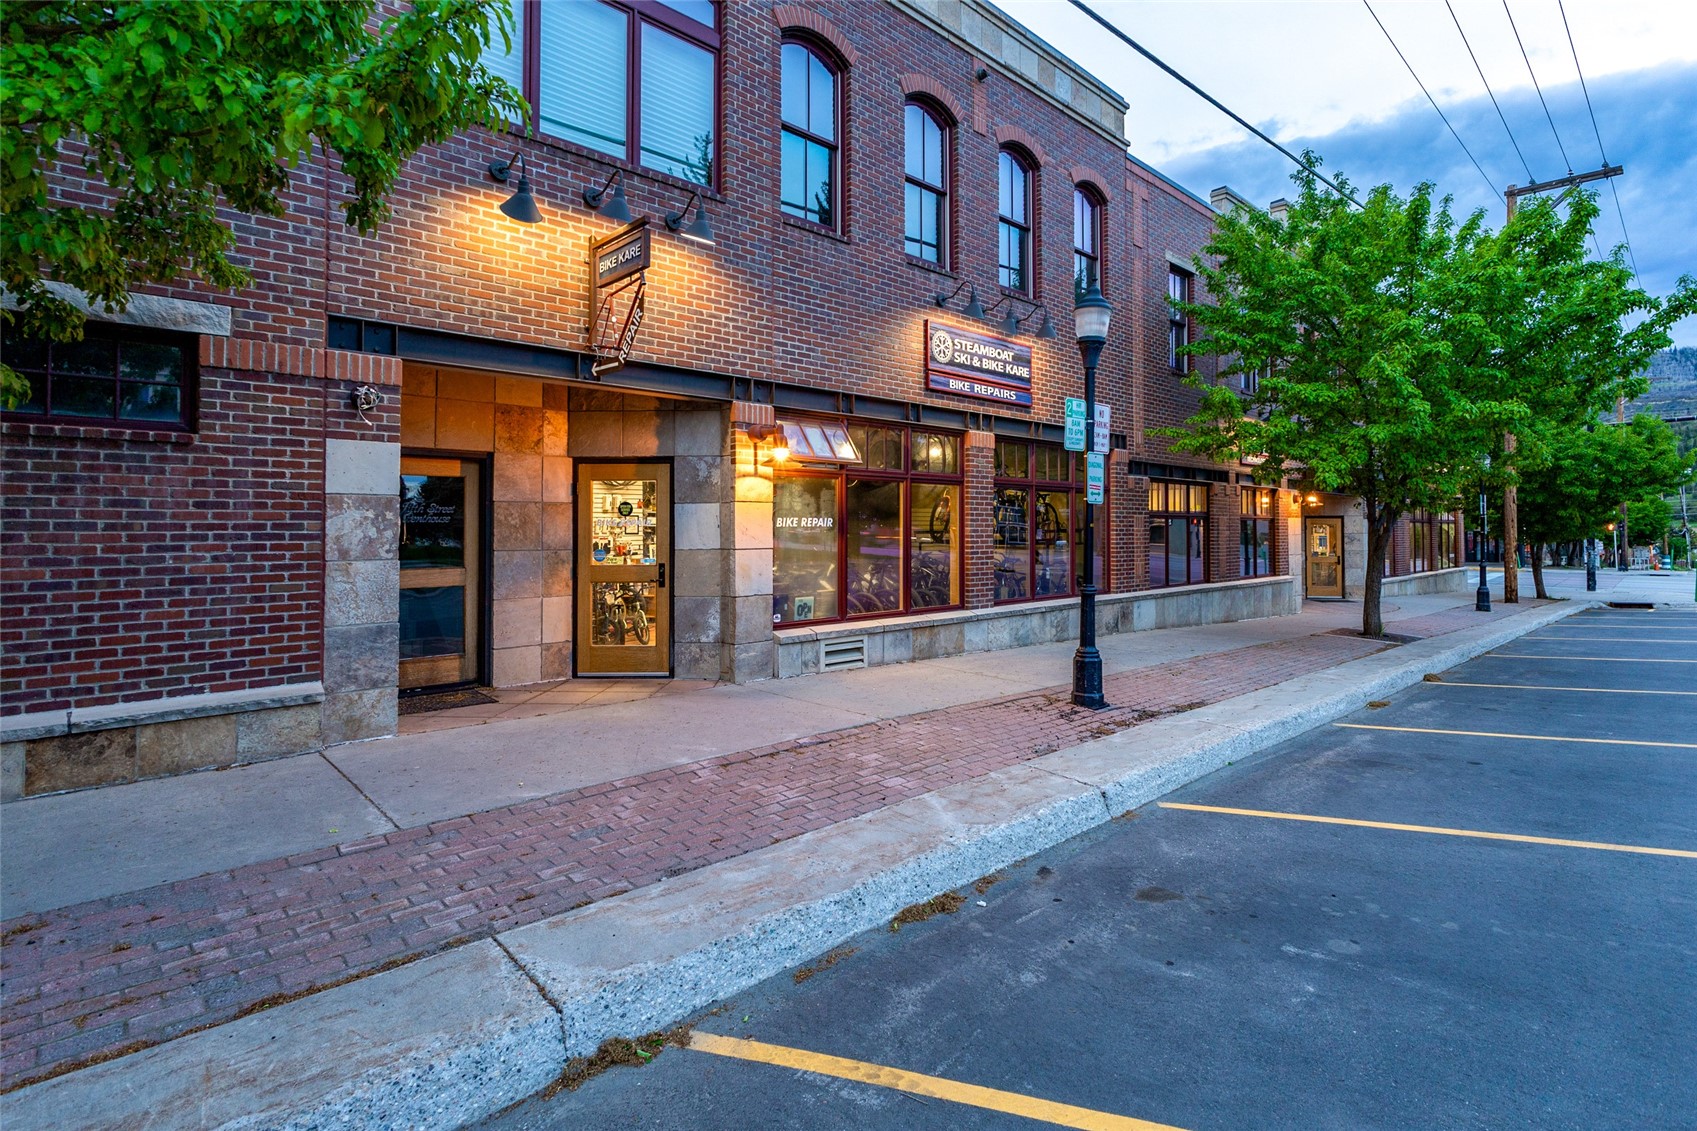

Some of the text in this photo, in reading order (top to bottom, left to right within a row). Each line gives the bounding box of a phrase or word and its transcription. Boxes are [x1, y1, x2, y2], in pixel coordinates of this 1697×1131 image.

[599, 243, 641, 273] BIKE KARE
[618, 307, 643, 364] REPAIR
[954, 338, 1014, 361] STEAMBOAT
[953, 352, 1030, 378] SKI & BIKE KARE
[949, 379, 1016, 400] BIKE REPAIRS
[1067, 401, 1072, 415] 2
[1099, 409, 1105, 419] NO
[1068, 427, 1073, 436] TO
[427, 502, 456, 514] Street
[776, 517, 834, 528] BIKE REPAIR
